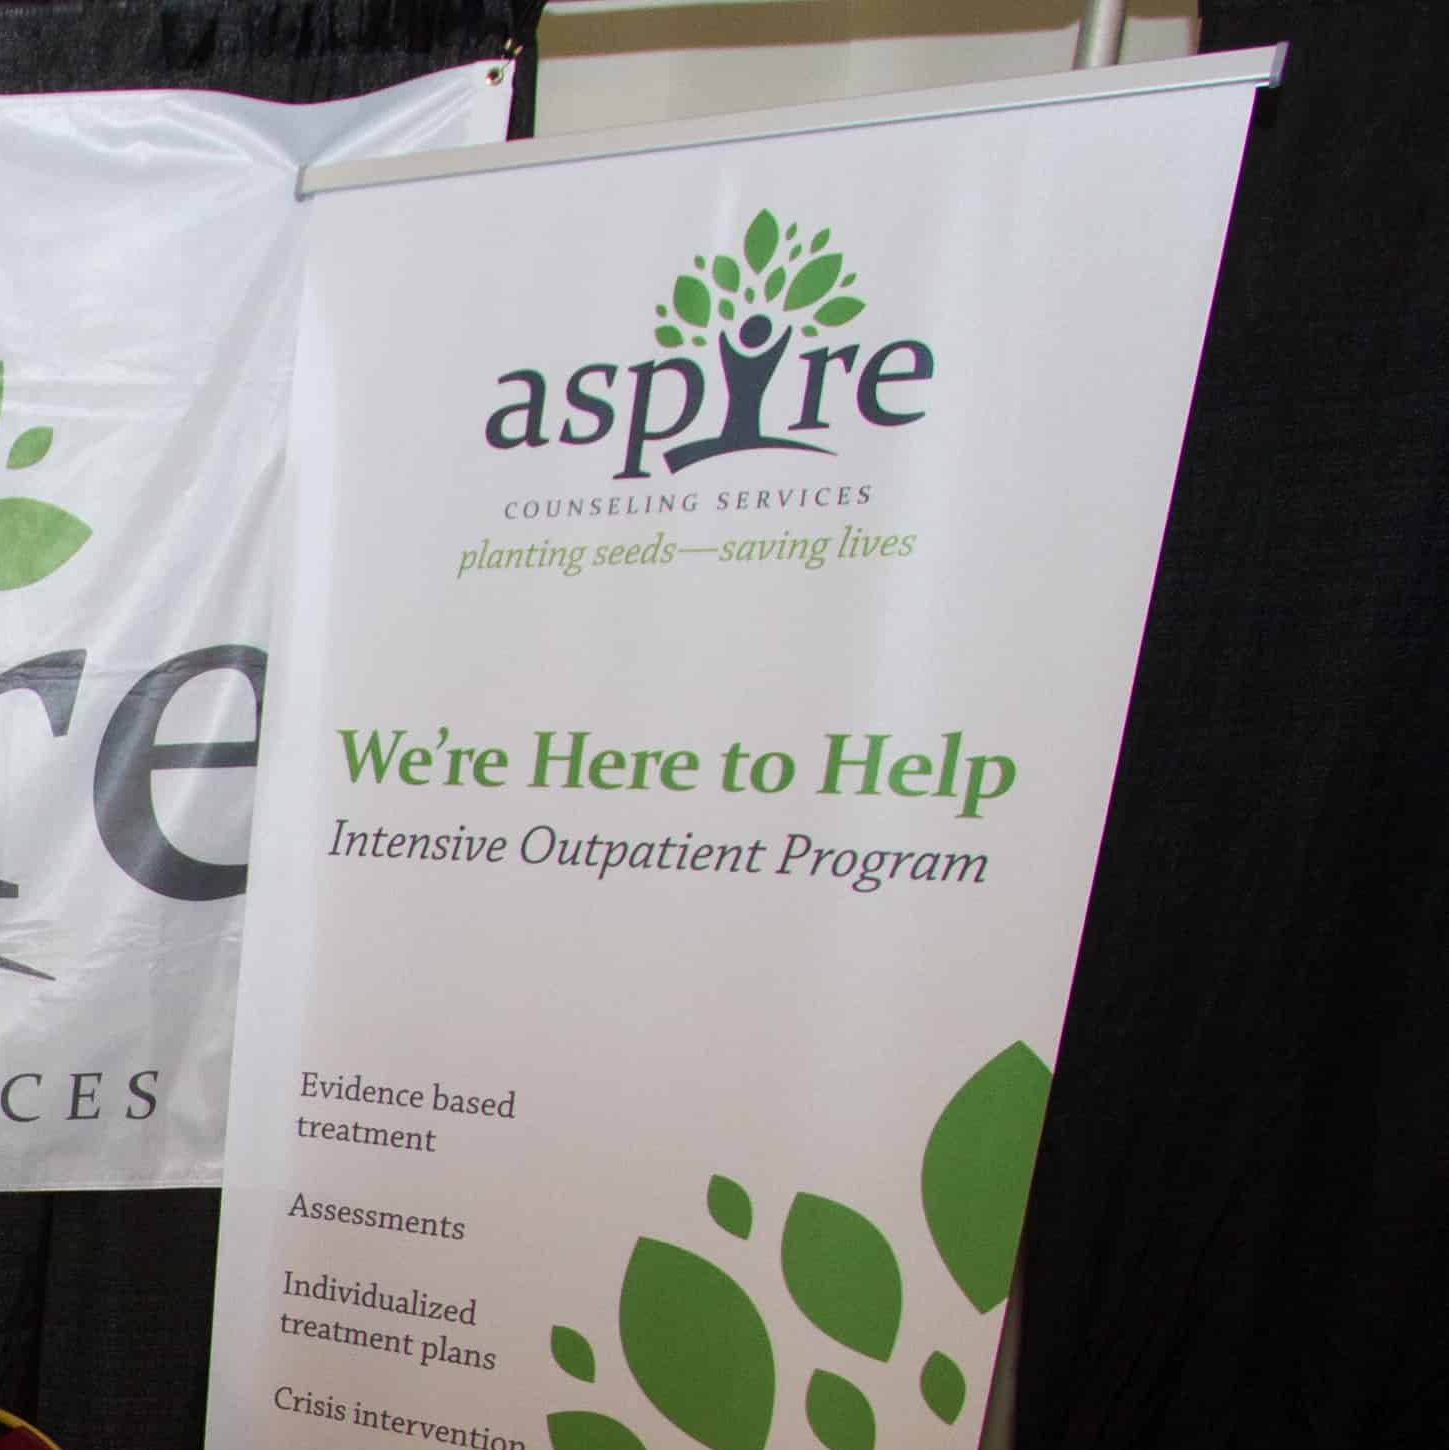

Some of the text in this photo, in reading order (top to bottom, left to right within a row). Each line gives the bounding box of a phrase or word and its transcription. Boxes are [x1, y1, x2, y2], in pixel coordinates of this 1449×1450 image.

[503, 483, 875, 521] COUNSELING SERVICES
[456, 537, 588, 580] planting
[836, 523, 919, 560] lives
[526, 730, 701, 793] Here
[720, 740, 797, 794] to
[815, 728, 1019, 820] Help
[327, 817, 991, 895] Intensive Outpatient Program
[299, 1071, 518, 1120] Evidence based
[296, 1114, 438, 1153] treatment
[287, 1191, 467, 1241] Assessments
[281, 1269, 478, 1327] Individualized
[279, 1312, 498, 1372] treatment plans
[273, 1385, 348, 1422] Crisis
